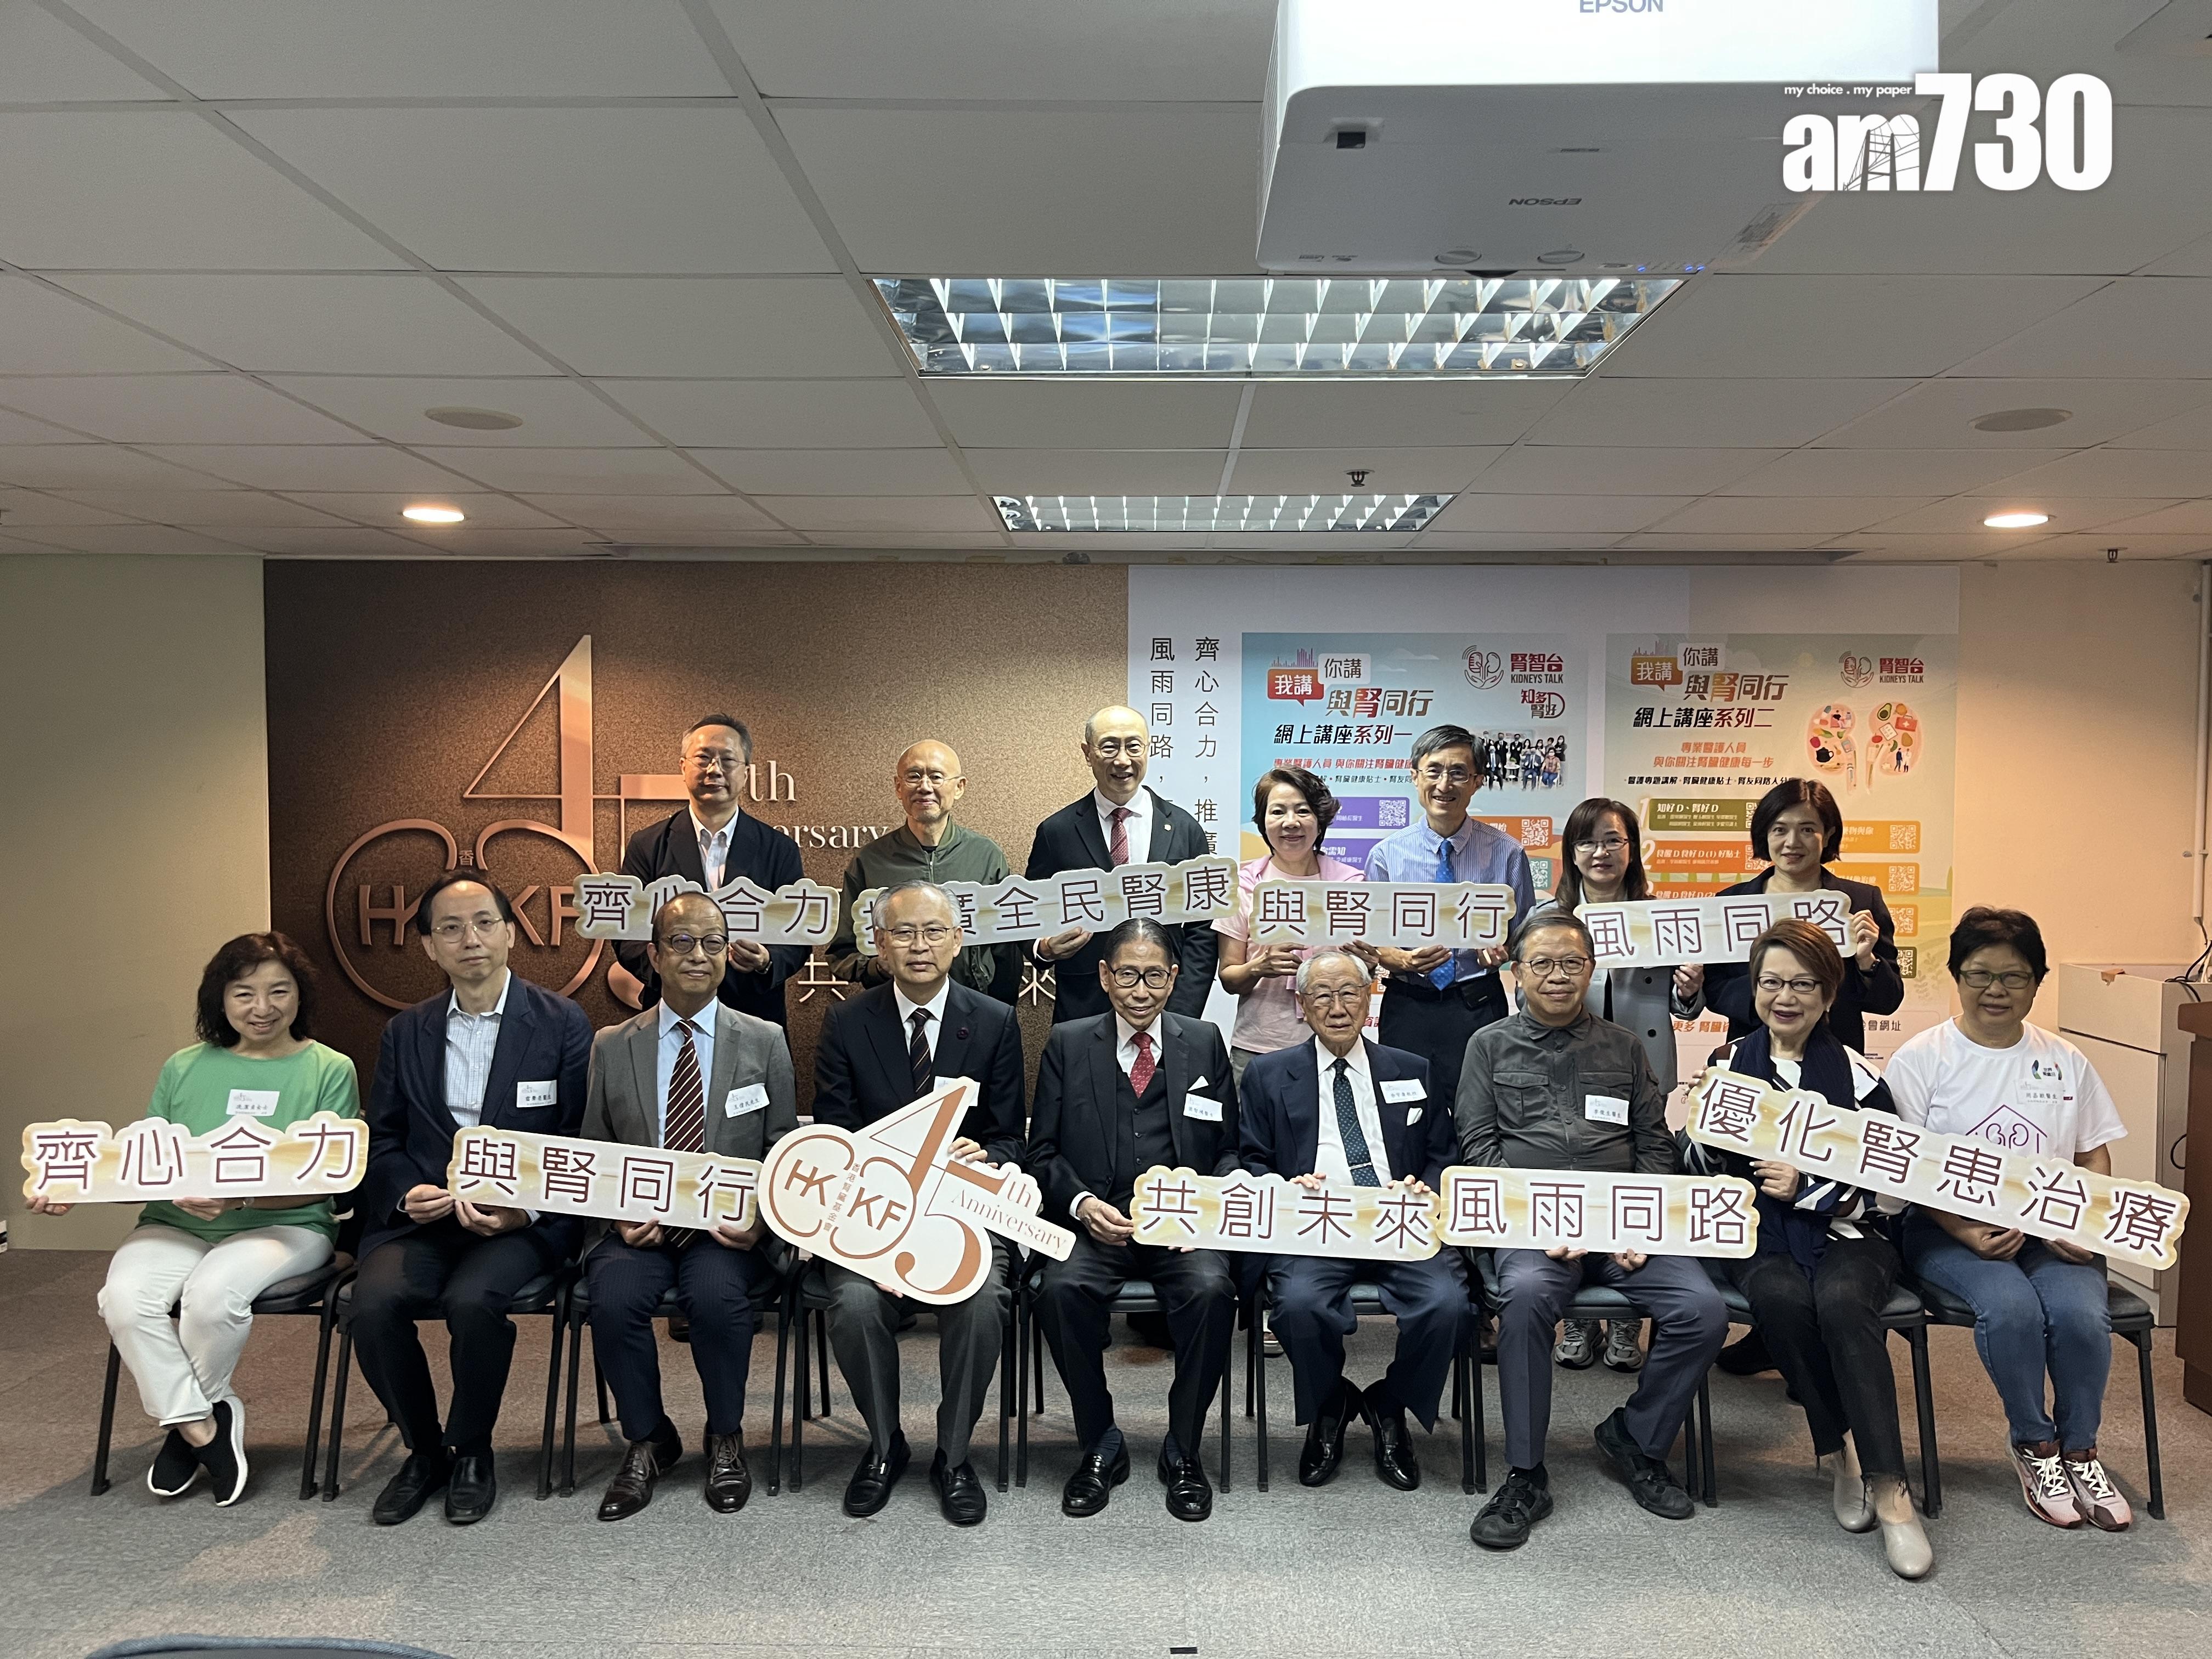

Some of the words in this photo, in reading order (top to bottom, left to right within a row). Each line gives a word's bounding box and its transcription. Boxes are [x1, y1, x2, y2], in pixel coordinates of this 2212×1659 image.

[1324, 658, 1362, 678] 你講
[1510, 653, 1564, 673] 腎智台
[1683, 647, 1719, 667] 你講
[1880, 658, 1925, 674] 腎智台
[1511, 674, 1542, 684] KIDNEYS
[1544, 674, 1564, 684] TALK
[1637, 662, 1673, 681] 我講
[1275, 675, 1312, 695] 我講
[1683, 673, 1790, 702] 與腎同行
[1325, 688, 1434, 718] 與腎同行
[1633, 707, 1775, 728] 網上講座系列二
[1273, 724, 1413, 744] 網上講座系列一
[748, 760, 797, 802] th
[1259, 889, 1506, 939] 與腎同行
[1863, 1020, 1901, 1031] 會網址
[36, 1122, 355, 1190] 齊心合力
[1699, 1079, 2177, 1257] 優化腎患治療
[460, 1138, 755, 1222] 與腎同行
[951, 1189, 1067, 1255] Anniversary
[1143, 1178, 1429, 1249] 共創未來
[1449, 1177, 1747, 1244] 風雨同路
